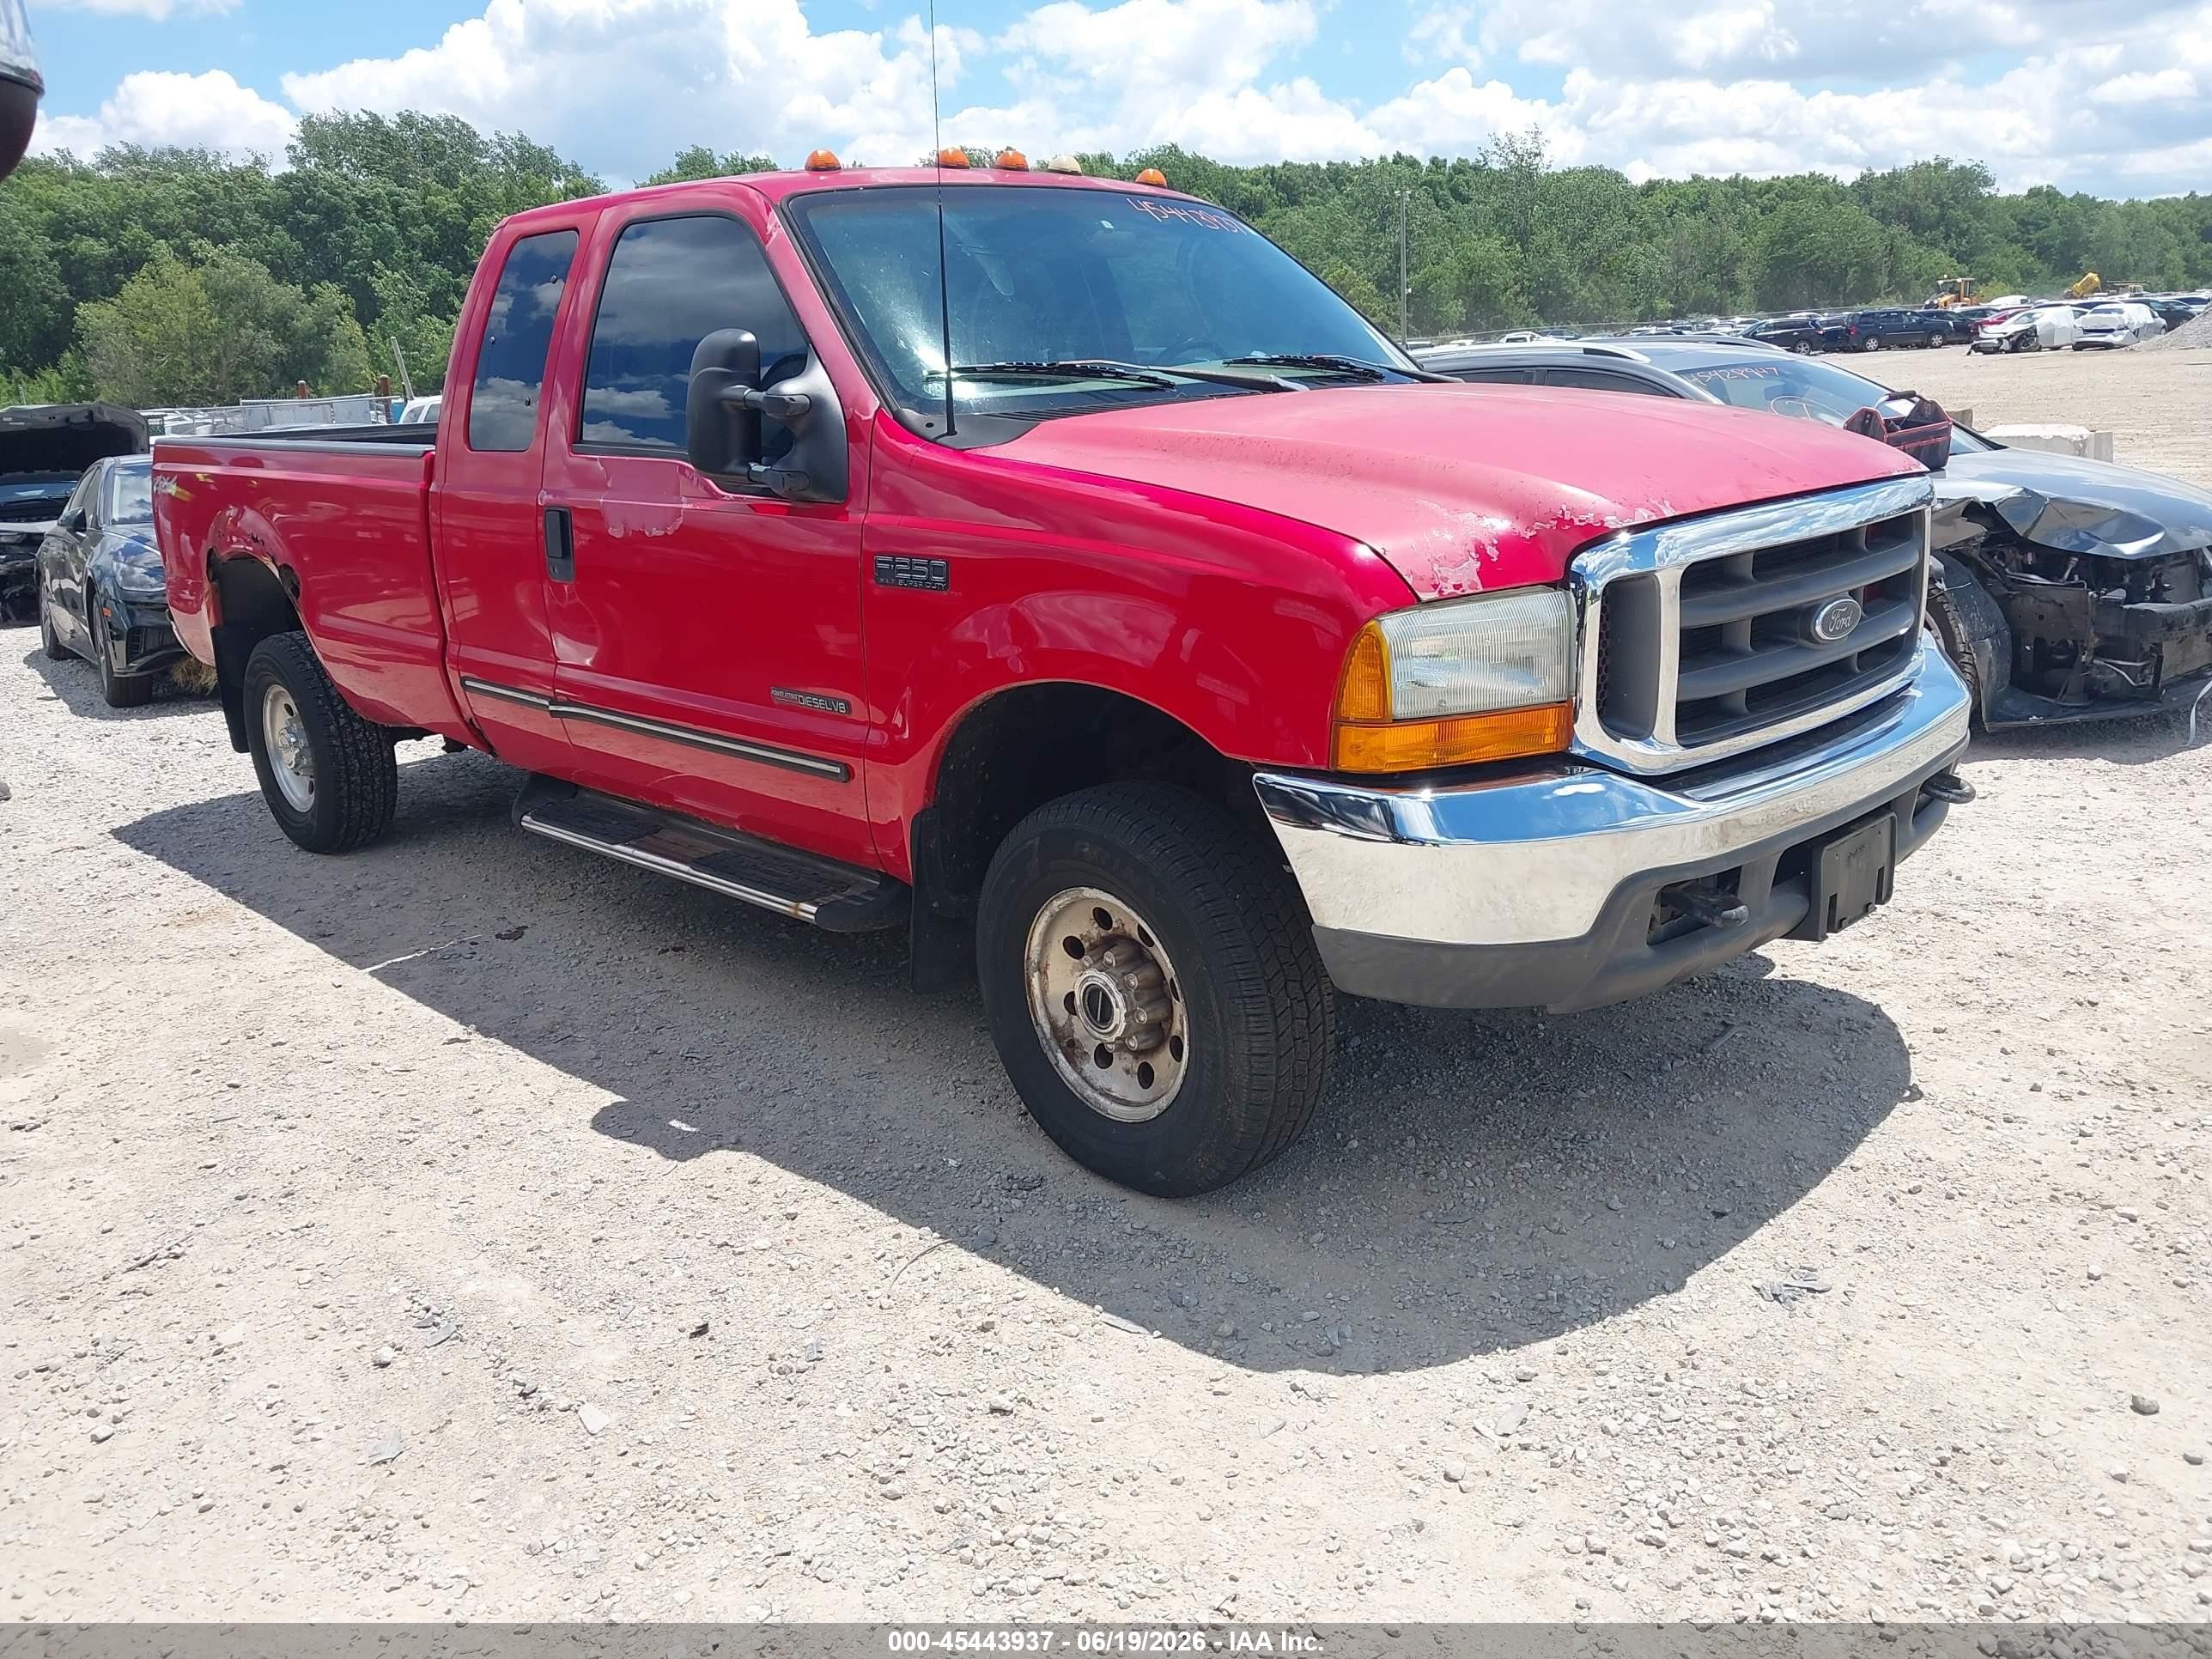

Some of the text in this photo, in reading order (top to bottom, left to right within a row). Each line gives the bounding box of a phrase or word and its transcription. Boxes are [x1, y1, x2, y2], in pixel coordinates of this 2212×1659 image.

[897, 579, 923, 588] SUPER
[925, 581, 947, 591] DUTY
[1828, 606, 1854, 633] Ford
